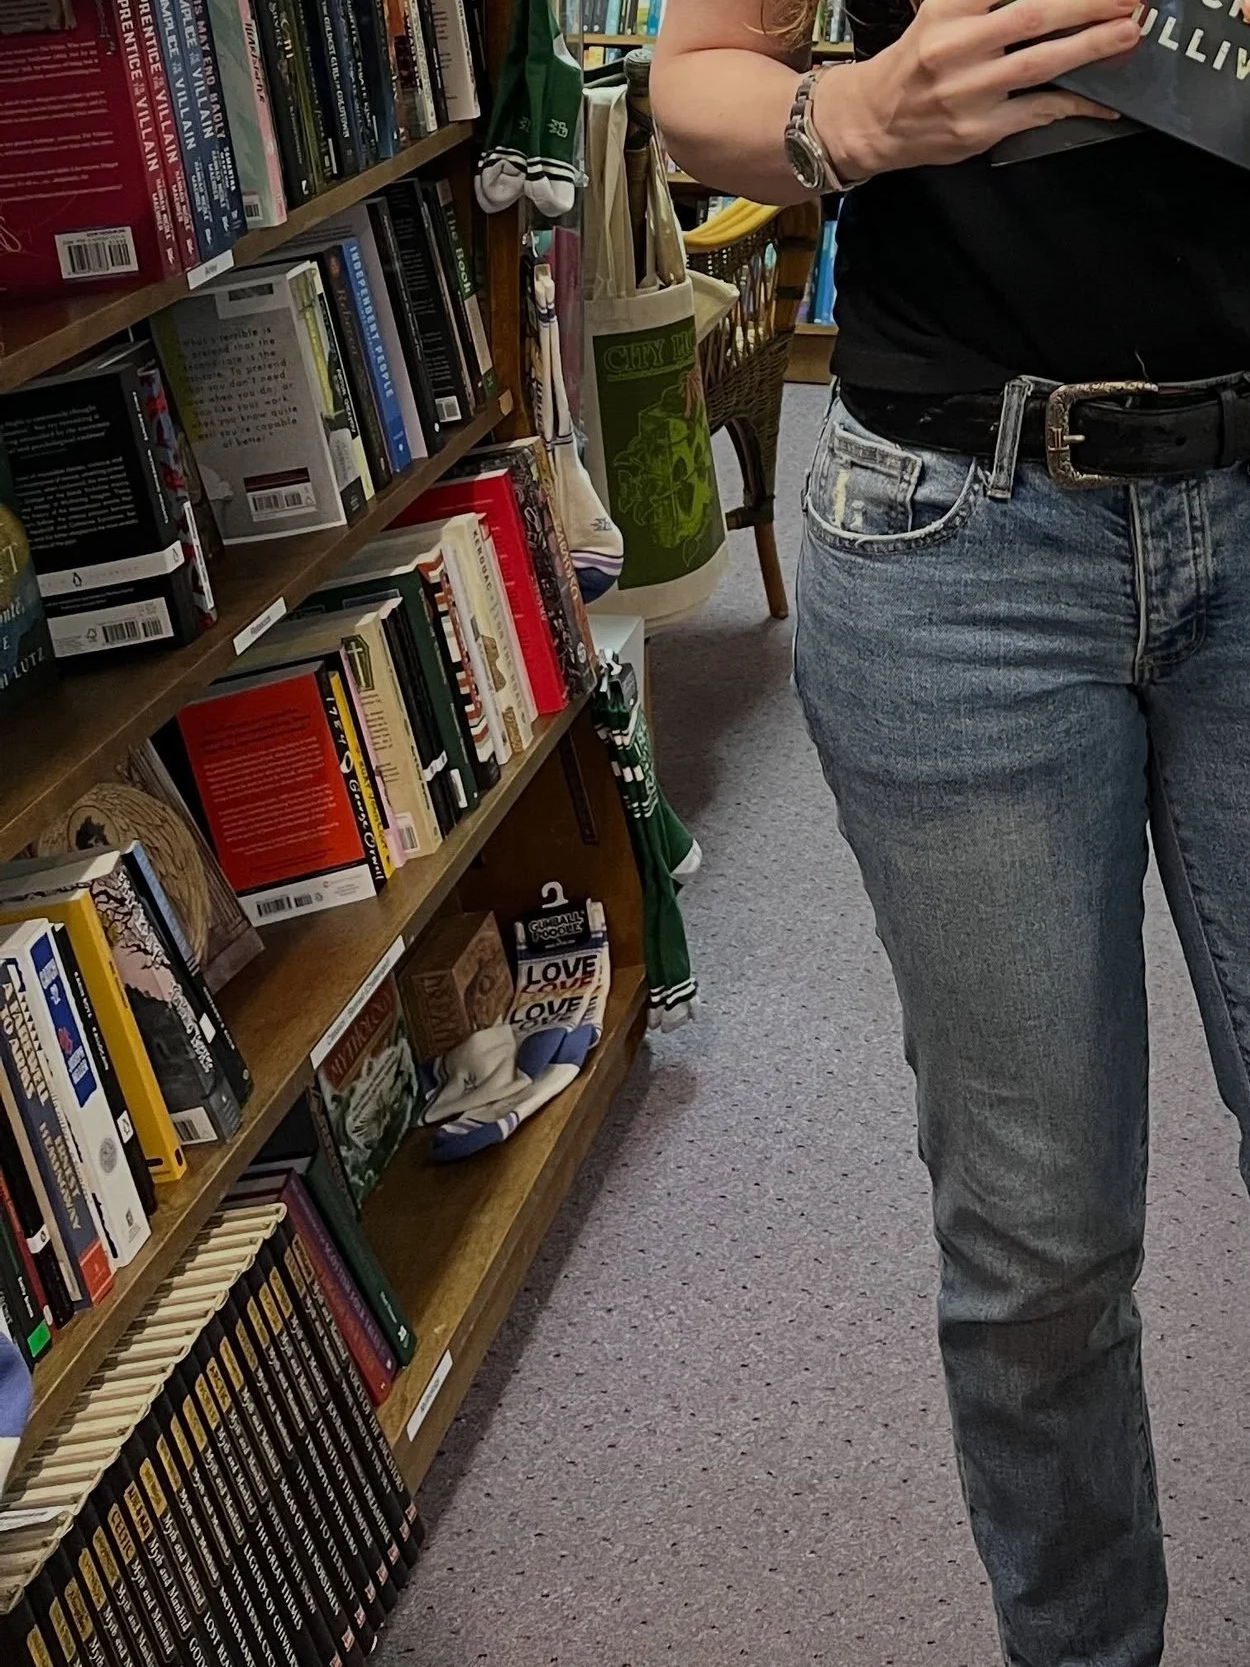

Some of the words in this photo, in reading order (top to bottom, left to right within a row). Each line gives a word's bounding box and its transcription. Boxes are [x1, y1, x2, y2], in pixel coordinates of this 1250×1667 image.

[197, 20, 212, 52] MAY
[267, 1, 283, 46] SILVER
[202, 56, 216, 86] END
[154, 91, 178, 163] VILLAIN
[173, 79, 196, 149] VILLAIN
[191, 68, 214, 138] VILLAIN
[209, 93, 226, 139] BADLY
[135, 98, 159, 171] VILLAIN
[445, 209, 459, 241] The
[454, 248, 472, 293] Book
[349, 246, 379, 340] INDEPENDENT
[374, 346, 394, 397] PEOPLE
[604, 338, 665, 374] CITY
[271, 406, 298, 419] quite
[472, 530, 493, 591] KEROUAC
[347, 778, 370, 831] George
[363, 830, 385, 881] Orwell
[526, 954, 598, 985] LOVE
[509, 995, 584, 1025] LOVE
[6, 1000, 52, 1105] FAREWELL
[7, 1038, 37, 1100] ARMS
[36, 1123, 82, 1231] HEMINGWAY
[50, 1136, 81, 1197] ERNEST
[314, 1418, 340, 1466] FORESTS
[377, 1438, 406, 1492] ANCESTORS
[245, 1455, 268, 1497] Mankind
[277, 1478, 298, 1515] SAGAS
[310, 1556, 342, 1616] NORSEMEN
[109, 1511, 136, 1559] CELTIC
[131, 1561, 148, 1590] Myth
[141, 1589, 156, 1609] and
[149, 1608, 175, 1655] Mankind
[147, 1538, 165, 1567] Myth
[158, 1567, 173, 1587] and
[166, 1586, 191, 1633] Mankind
[262, 1545, 284, 1582] GREAT
[277, 1581, 305, 1630] THEMES
